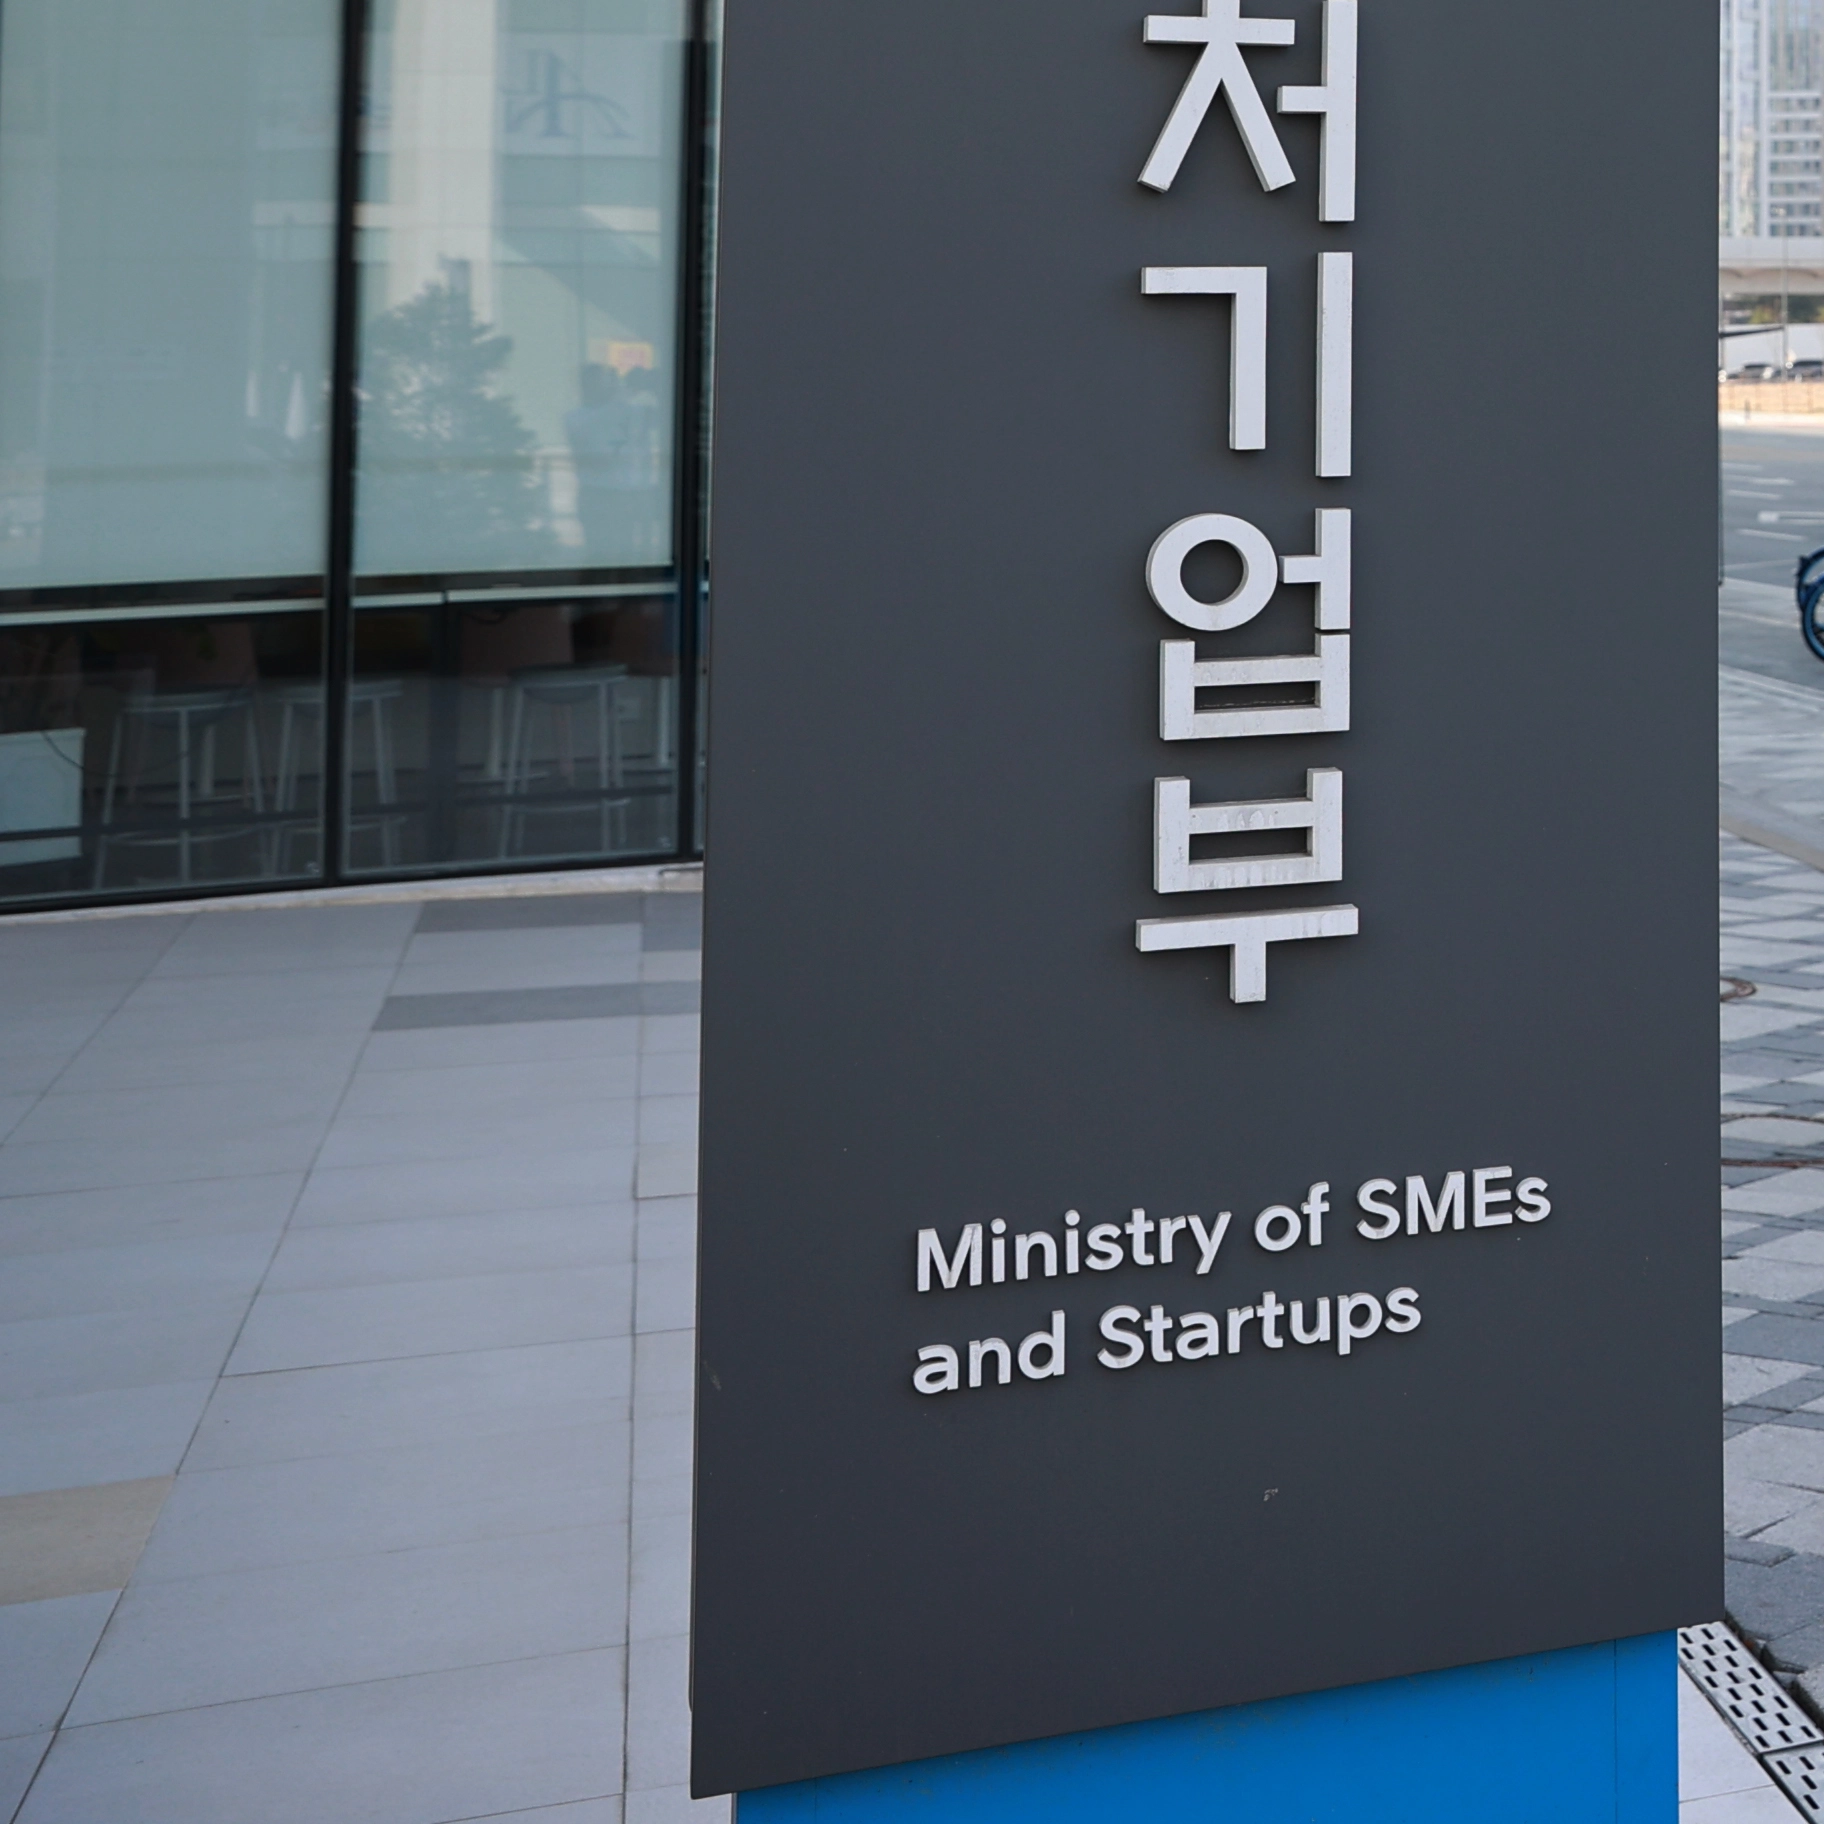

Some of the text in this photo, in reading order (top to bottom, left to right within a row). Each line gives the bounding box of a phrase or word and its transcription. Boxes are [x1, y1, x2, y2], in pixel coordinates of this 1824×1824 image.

[915, 1165, 1552, 1293] Ministry of SMEs
[912, 1286, 1423, 1395] and Startups
